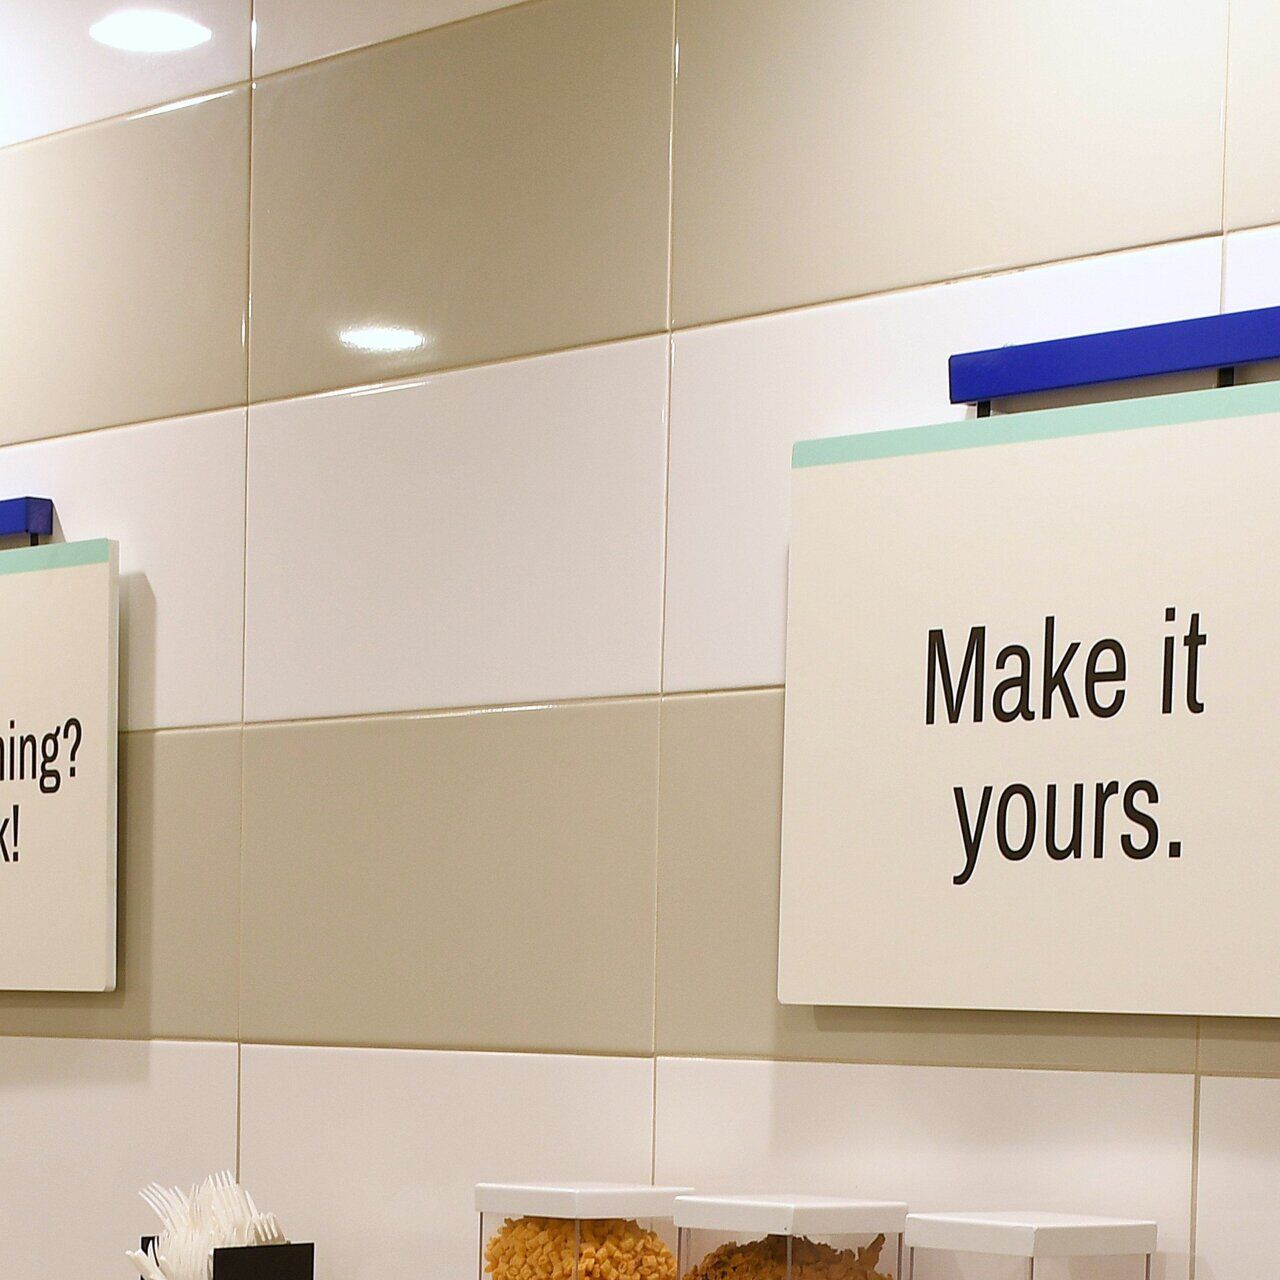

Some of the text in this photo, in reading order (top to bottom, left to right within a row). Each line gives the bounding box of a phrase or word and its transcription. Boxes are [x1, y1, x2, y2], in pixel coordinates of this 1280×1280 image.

[925, 607, 1207, 725] Make it
[953, 779, 1182, 885] yours.
